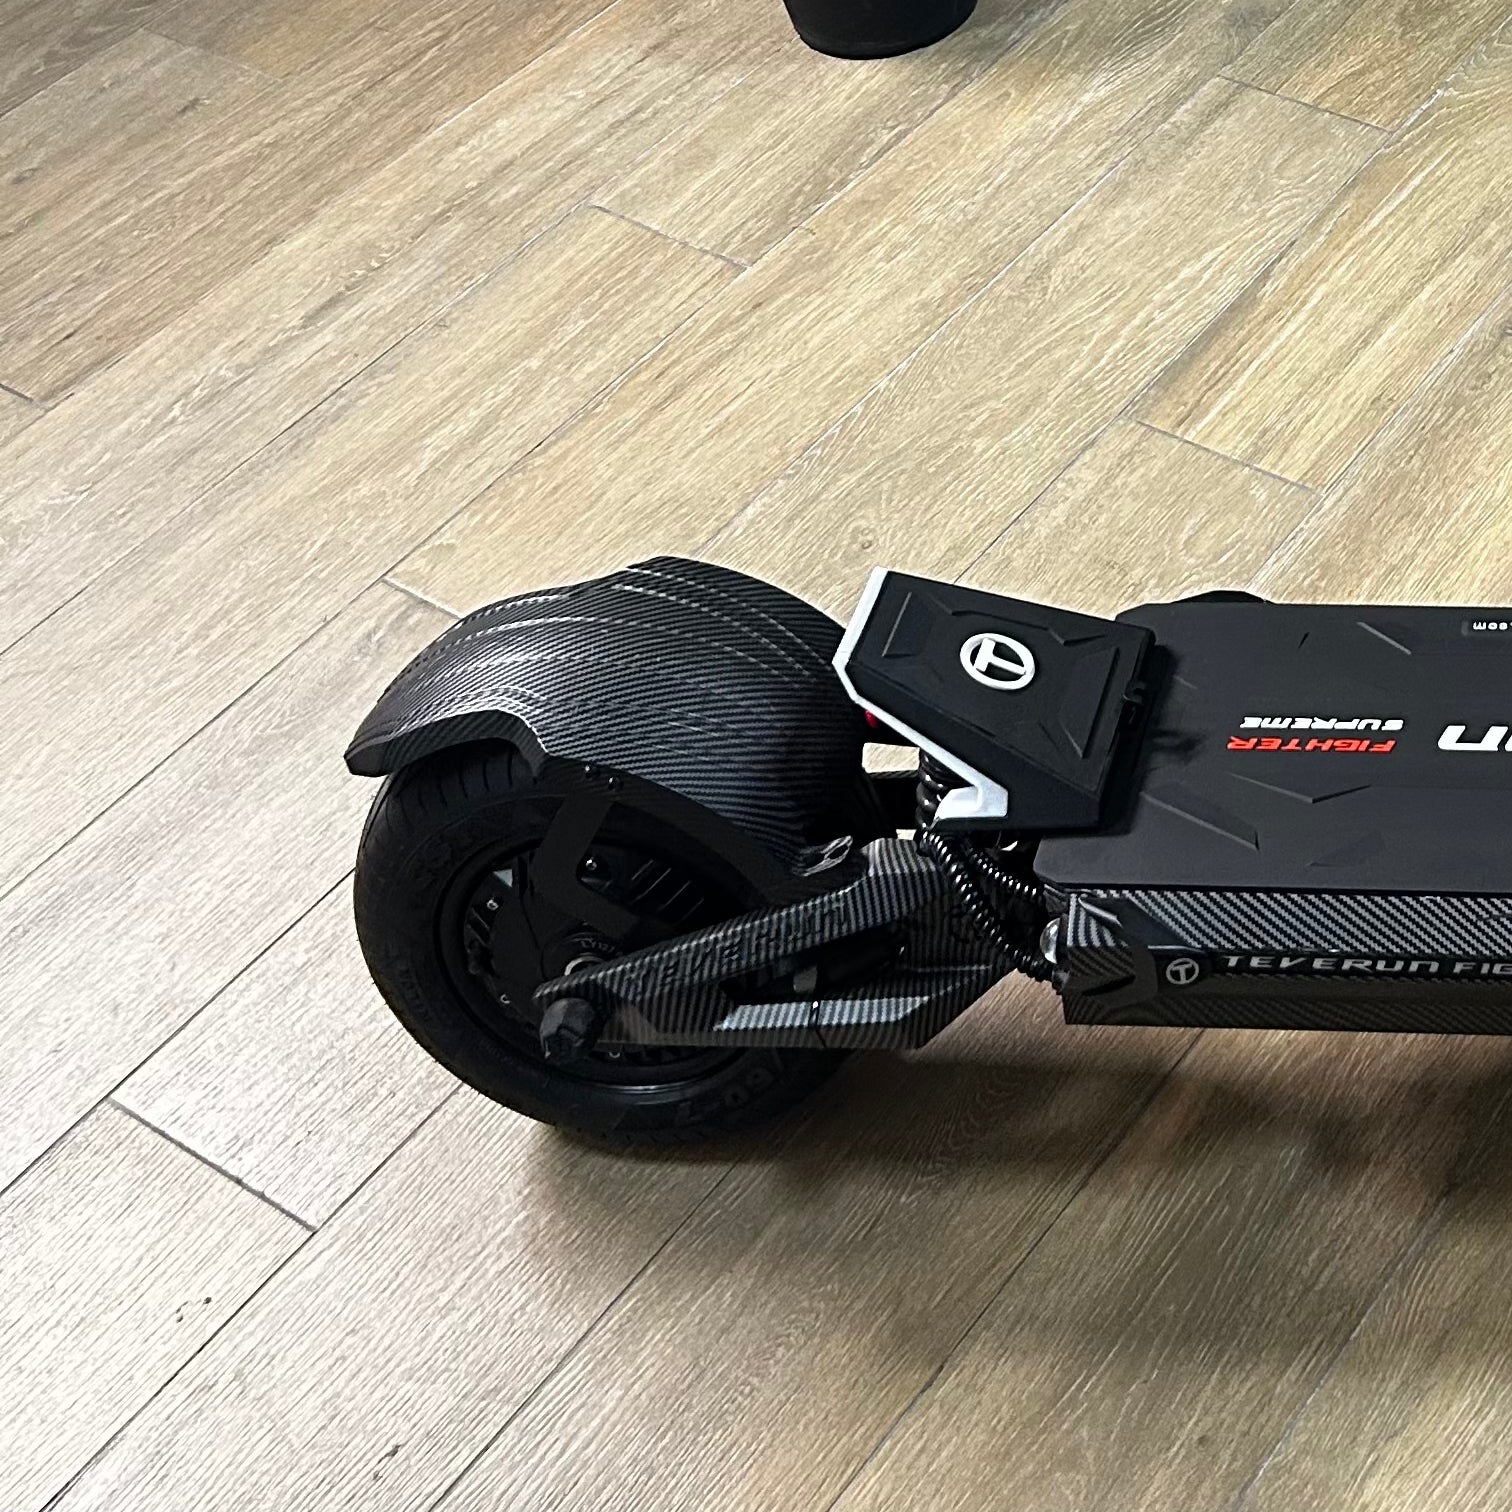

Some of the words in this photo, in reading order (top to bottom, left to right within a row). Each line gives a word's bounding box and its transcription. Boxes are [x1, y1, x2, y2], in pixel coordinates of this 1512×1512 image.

[1239, 715, 1405, 732] SUPREME
[1225, 735, 1397, 753] FIGHTER
[1221, 954, 1440, 974] TEVERUN
